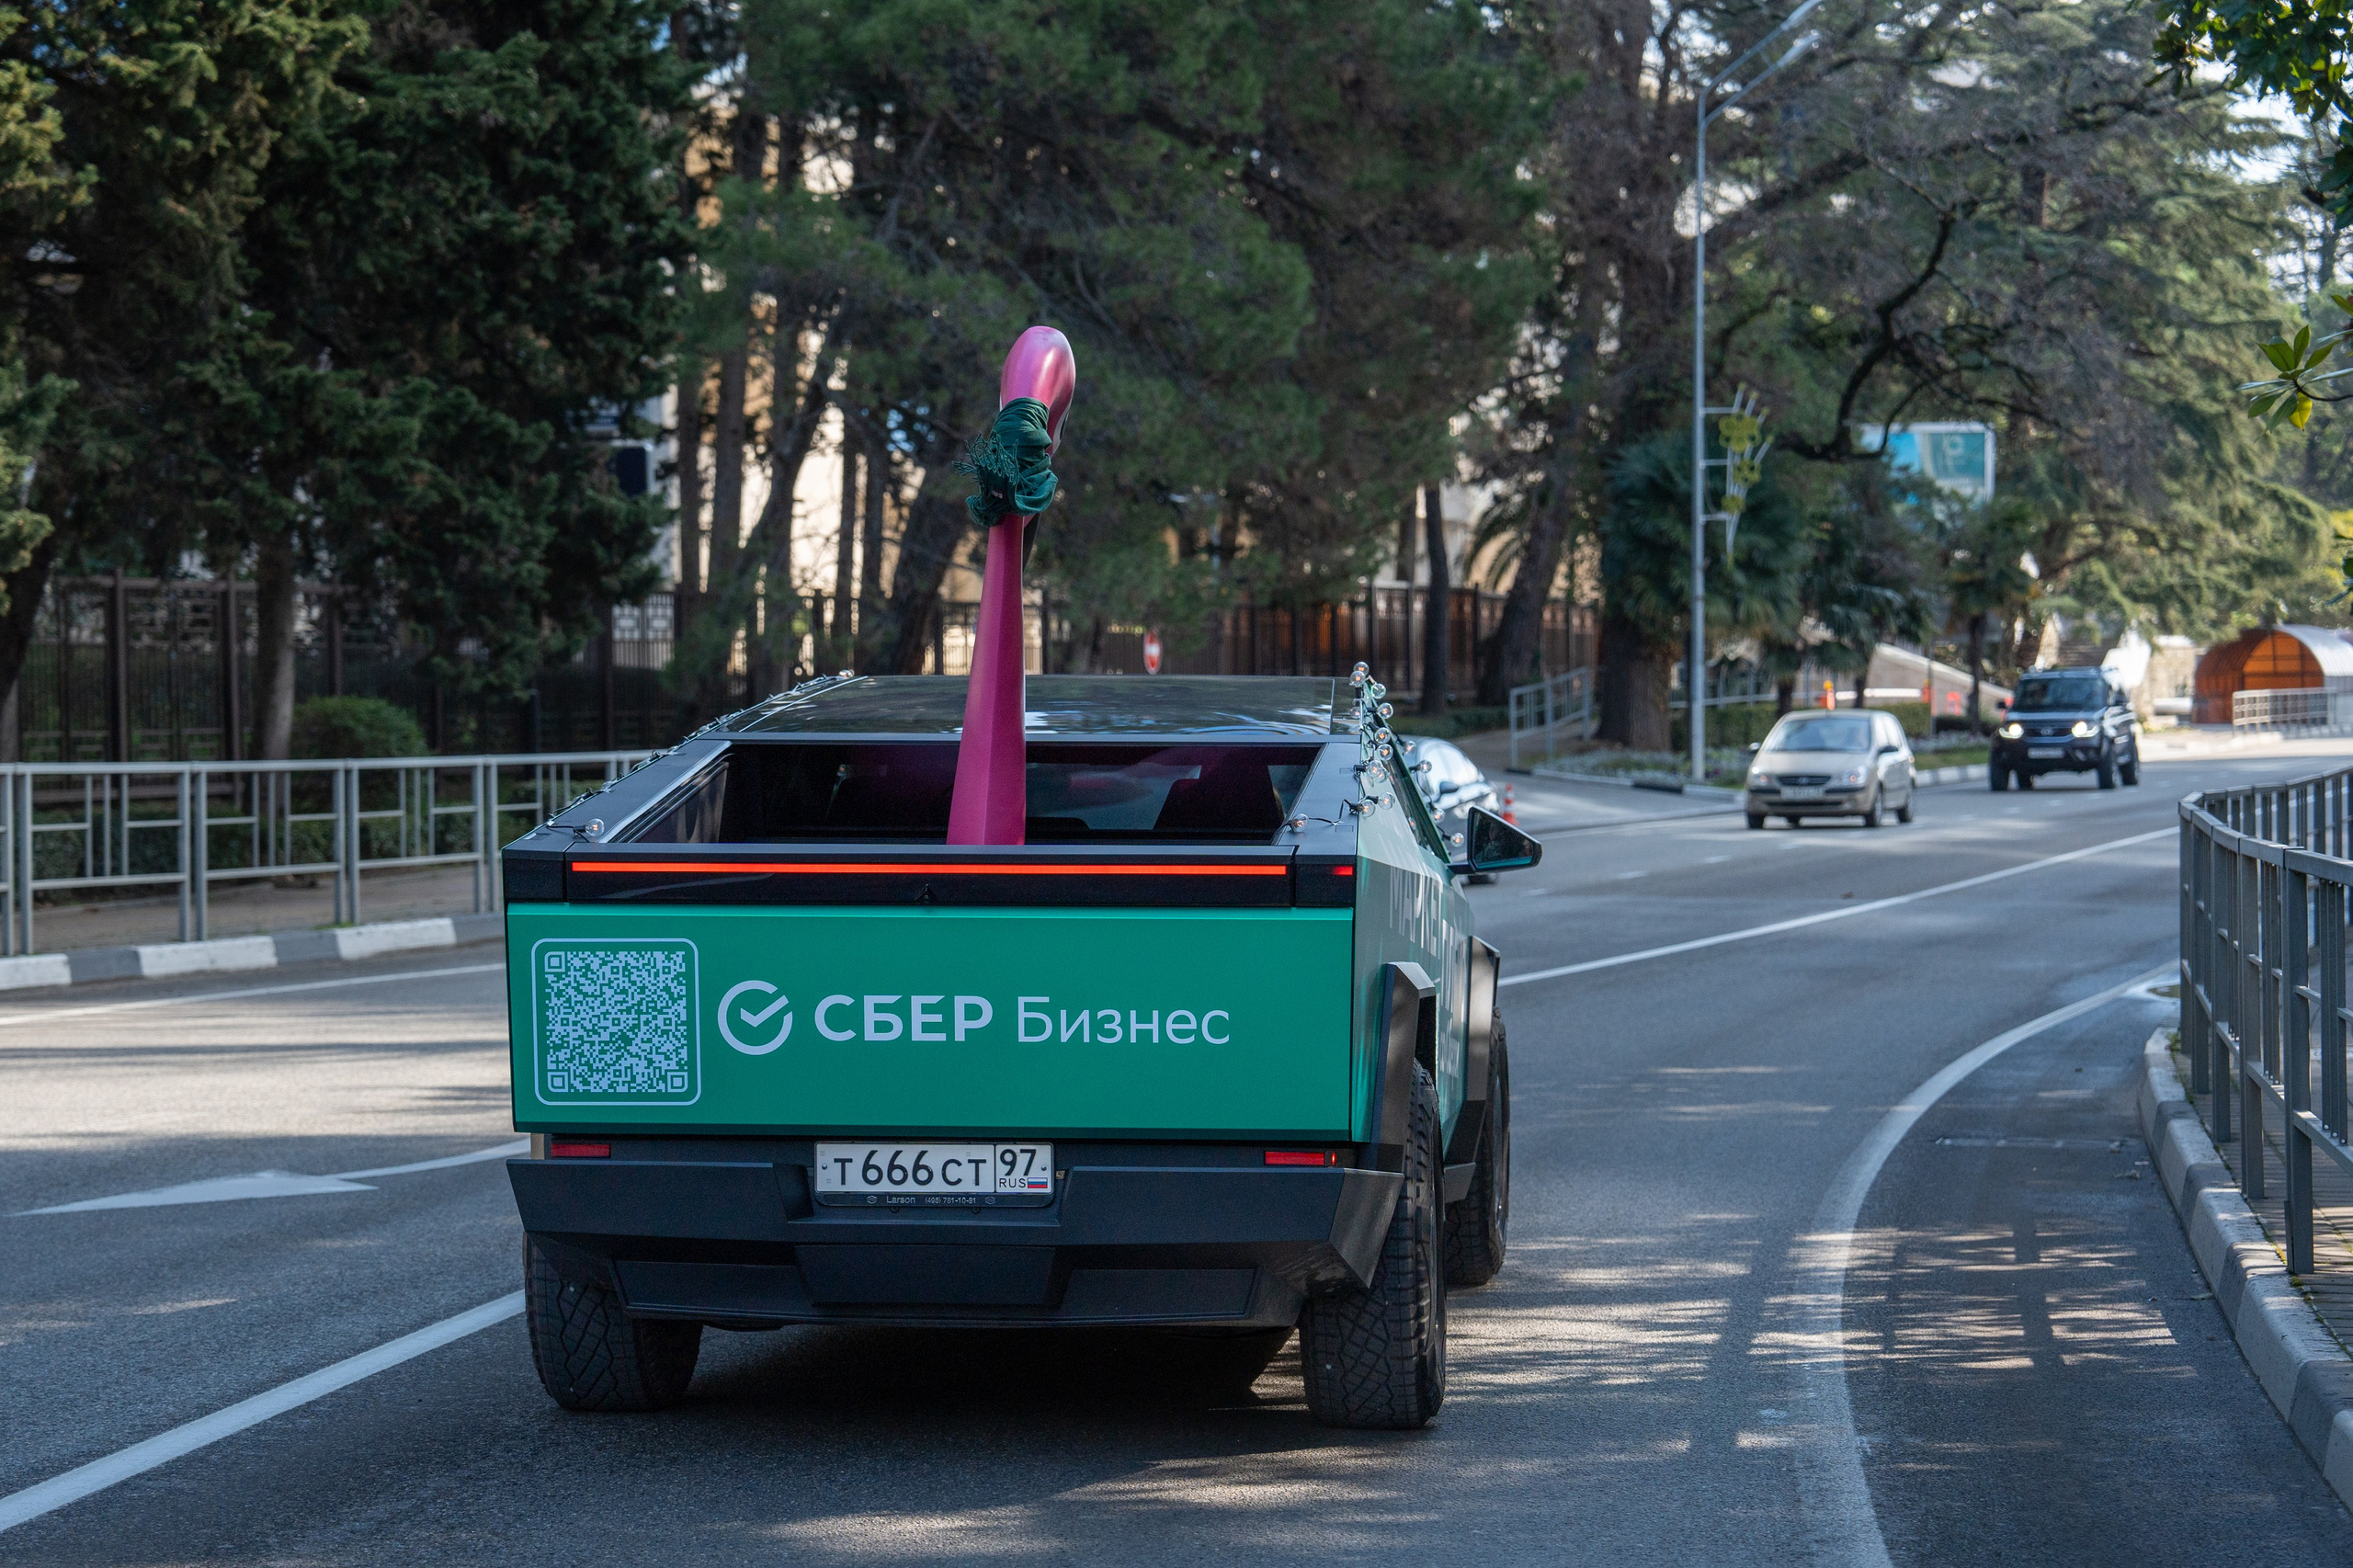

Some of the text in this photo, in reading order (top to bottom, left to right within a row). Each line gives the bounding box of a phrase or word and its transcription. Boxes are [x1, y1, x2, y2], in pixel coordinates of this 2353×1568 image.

[814, 994, 1230, 1044] СБЕР Бизнес
[999, 1149, 1037, 1176] 97
[998, 1177, 1027, 1188] RUS
[886, 1195, 916, 1204] Larson
[924, 1197, 942, 1205] (495)
